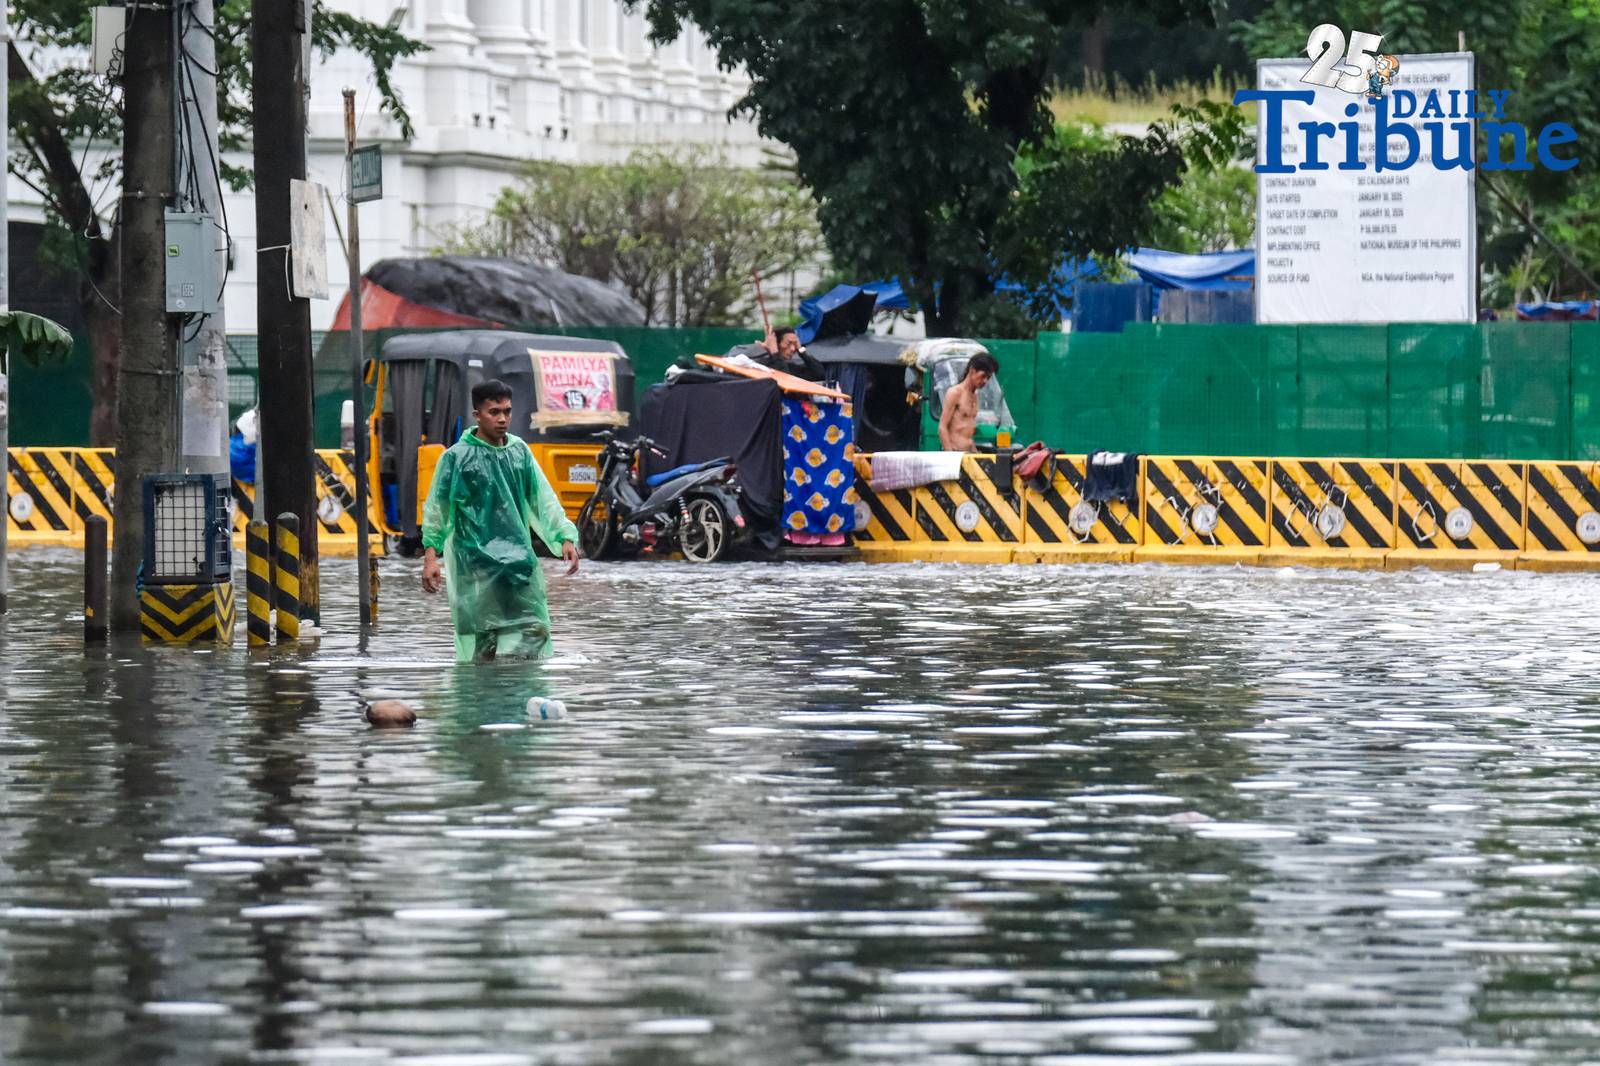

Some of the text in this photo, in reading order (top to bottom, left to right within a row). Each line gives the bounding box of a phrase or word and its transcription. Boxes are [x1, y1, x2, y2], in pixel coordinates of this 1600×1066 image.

[1265, 177, 1316, 187] CONTRACT DURATION
[1367, 176, 1394, 185] CALENDAR
[1395, 176, 1410, 185] DAYS
[1266, 193, 1301, 203] DATE STARTED
[1358, 192, 1381, 202] JANUARY
[1286, 209, 1298, 219] DATE
[1300, 209, 1306, 218] OF
[1307, 209, 1338, 218] COMPLETION
[1359, 208, 1383, 218] JANUARY
[1266, 225, 1306, 235] CONTRACT COST
[1303, 241, 1320, 250] OFFICE
[1360, 239, 1461, 249] NATIONAL MUSEUM OF THE PHILIPPINES
[1267, 258, 1289, 267] PROJECT
[1267, 273, 1310, 282] SOURCE OF FUND
[1384, 272, 1404, 281] National
[1405, 272, 1434, 282] Expenditure
[1434, 271, 1454, 283] Program
[541, 355, 608, 371] PAMILYA
[544, 374, 596, 388] MUNA
